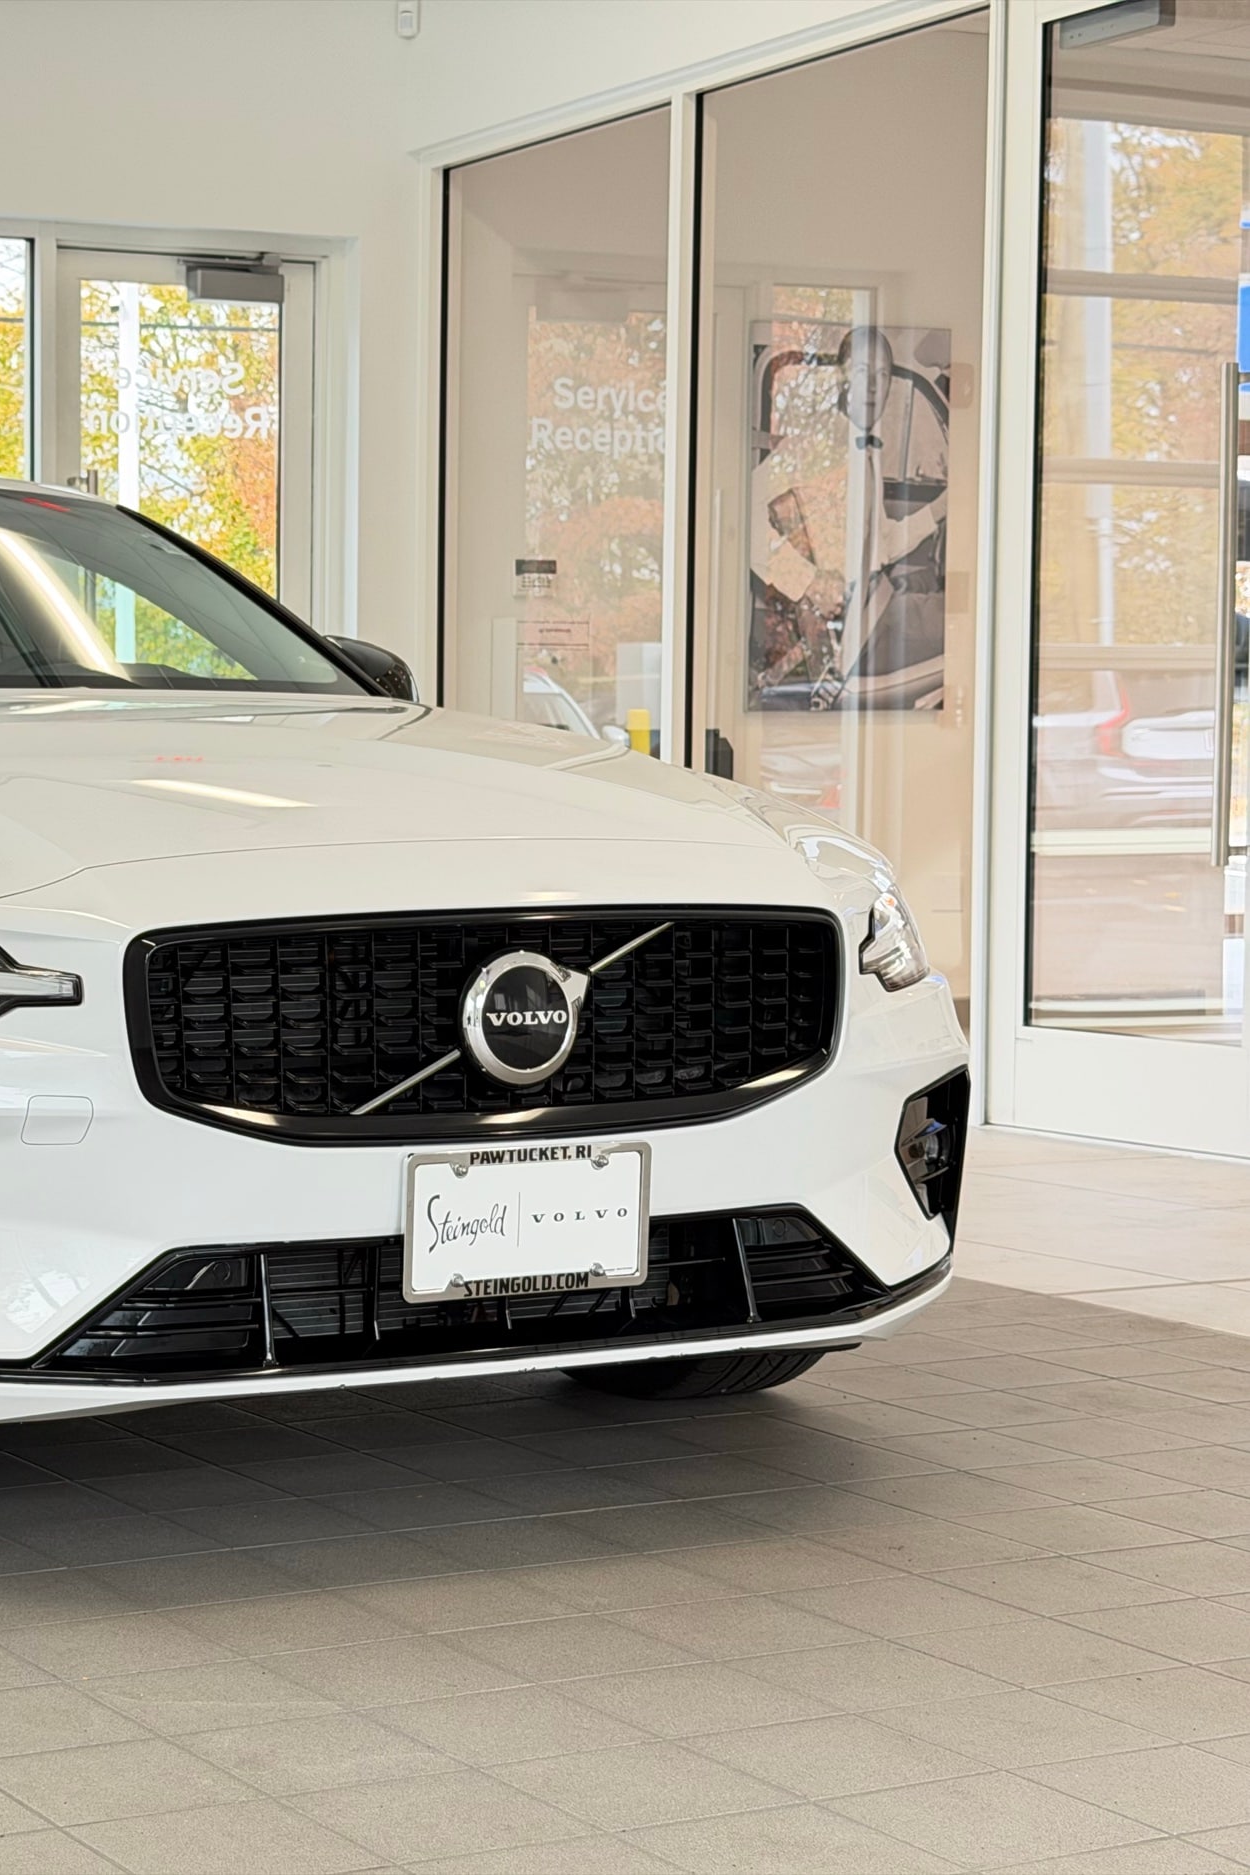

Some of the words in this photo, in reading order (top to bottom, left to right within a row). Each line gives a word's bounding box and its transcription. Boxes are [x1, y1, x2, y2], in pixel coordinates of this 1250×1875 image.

[486, 1010, 567, 1026] VOLVO
[576, 1145, 592, 1159] RI
[427, 1194, 508, 1254] Steingold
[531, 1207, 628, 1223] VOLVO
[464, 1272, 589, 1297] STEINGOLD.COM
